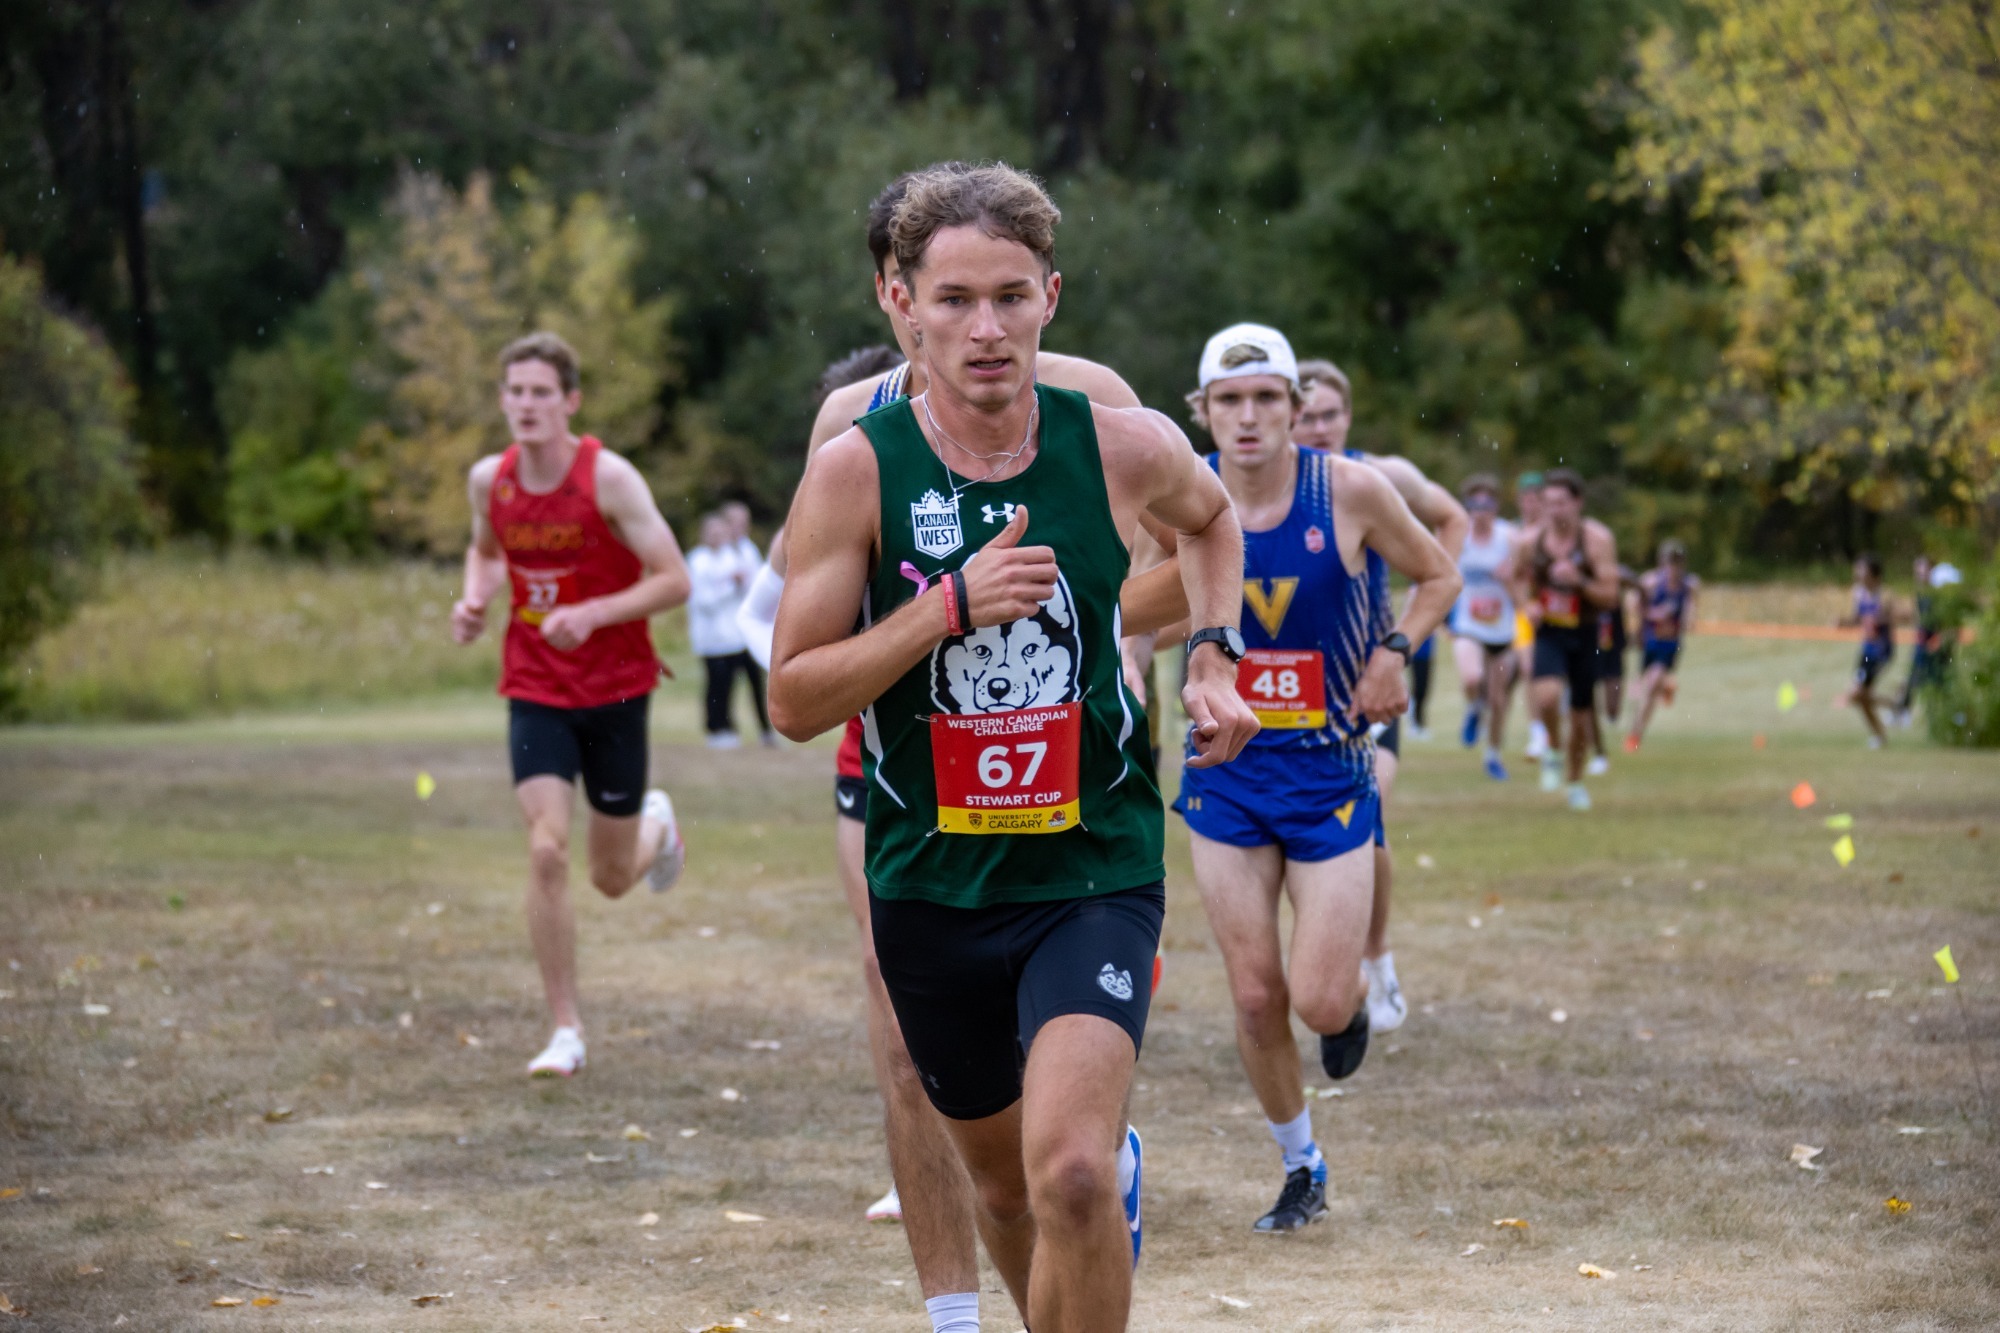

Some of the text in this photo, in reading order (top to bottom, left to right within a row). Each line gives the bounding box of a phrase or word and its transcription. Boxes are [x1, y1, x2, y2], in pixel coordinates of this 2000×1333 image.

[918, 514, 956, 527] CANADA
[920, 528, 956, 546] WEST
[1243, 575, 1299, 641] V
[1251, 669, 1300, 699] 48
[947, 709, 1068, 729] WESTERN CANADIAN
[974, 721, 1044, 737] CHALLENGE
[977, 741, 1048, 789] 67
[965, 791, 1062, 806] STEWART CUP
[988, 819, 1043, 829] CALGARY
